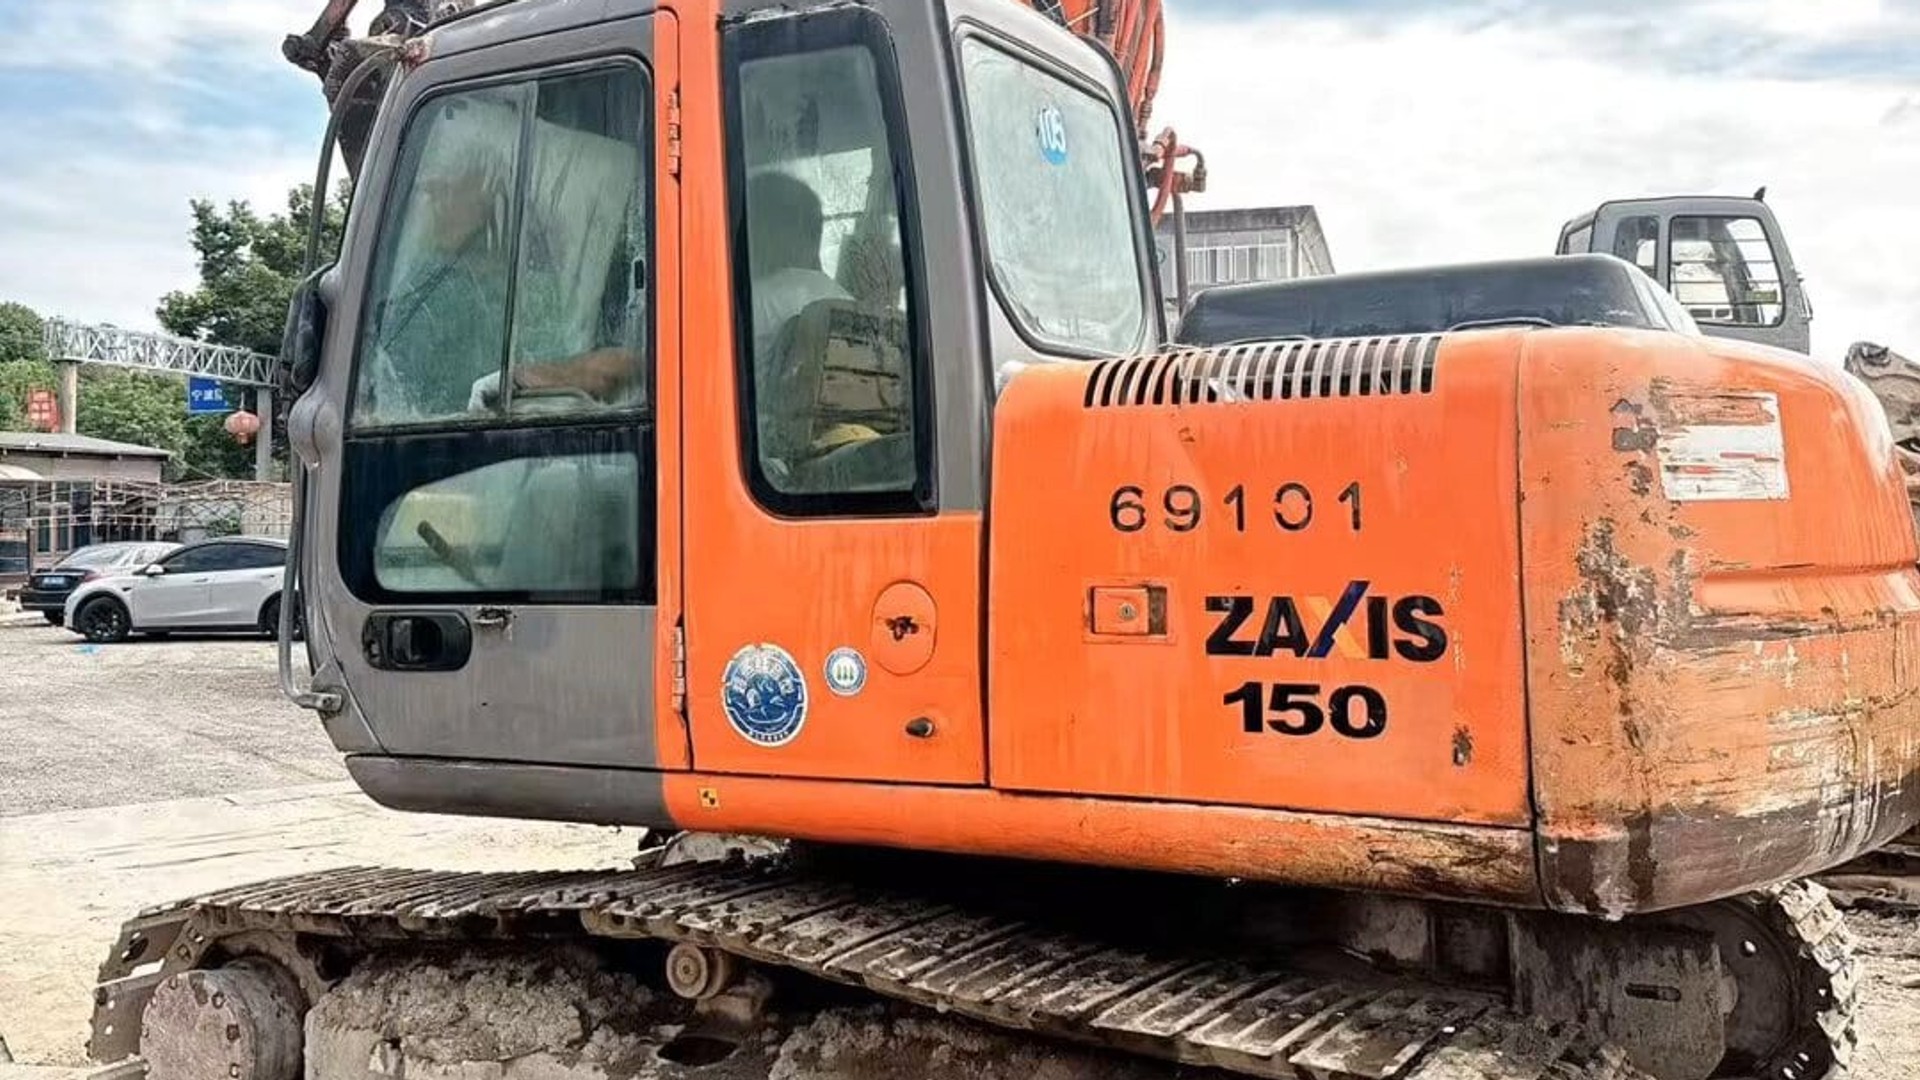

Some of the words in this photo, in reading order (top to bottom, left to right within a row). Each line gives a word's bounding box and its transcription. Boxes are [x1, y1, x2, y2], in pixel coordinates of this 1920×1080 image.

[1110, 481, 1362, 532] 69101
[1205, 580, 1448, 662] ZAXIS
[1222, 681, 1387, 739] 150
